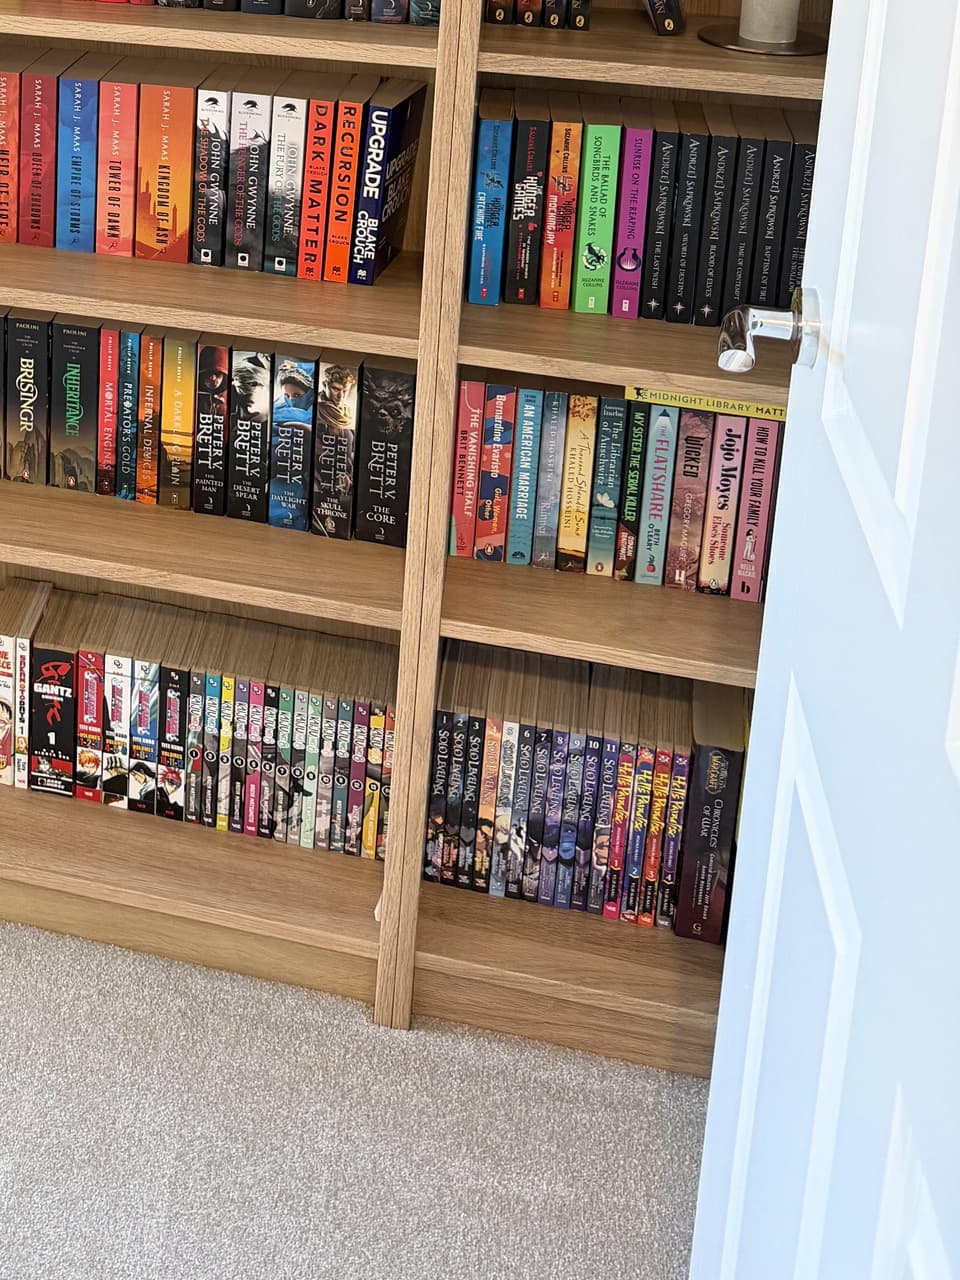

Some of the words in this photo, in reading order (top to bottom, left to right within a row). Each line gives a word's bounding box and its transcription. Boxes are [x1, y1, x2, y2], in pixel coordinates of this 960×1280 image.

[210, 137, 221, 169] JOHN
[311, 105, 328, 161] DARK
[363, 111, 388, 199] UPGRADE
[250, 143, 260, 172] JOHN
[335, 105, 357, 222] RECURSION
[209, 174, 219, 225] GWYNNE
[246, 176, 258, 229] GWYNNE
[512, 183, 527, 221] GAMES
[525, 176, 538, 217] HUNGER
[304, 180, 322, 263] MATTER
[353, 210, 369, 264] CROUCH
[364, 219, 379, 260] BLAKE
[544, 195, 559, 245] MOCKINGJAY
[17, 357, 38, 432] BRISINGR
[63, 362, 84, 437] INHERITANCE
[235, 420, 250, 476] BRETT
[250, 422, 262, 460] PETER
[459, 430, 467, 450] BRIT
[683, 436, 701, 477] WICKED
[724, 428, 742, 461] Jojo
[320, 435, 336, 493] BRETT
[369, 441, 386, 499] BRETT
[457, 454, 466, 496] BENNETT
[650, 439, 669, 520] FLATSHARE
[716, 463, 738, 510] Moyes
[316, 507, 347, 519] THRONE
[366, 512, 396, 525] CORE
[717, 515, 732, 561] Someone
[34, 683, 72, 698] GANTZ
[557, 736, 563, 744] 8
[606, 744, 616, 752] 11
